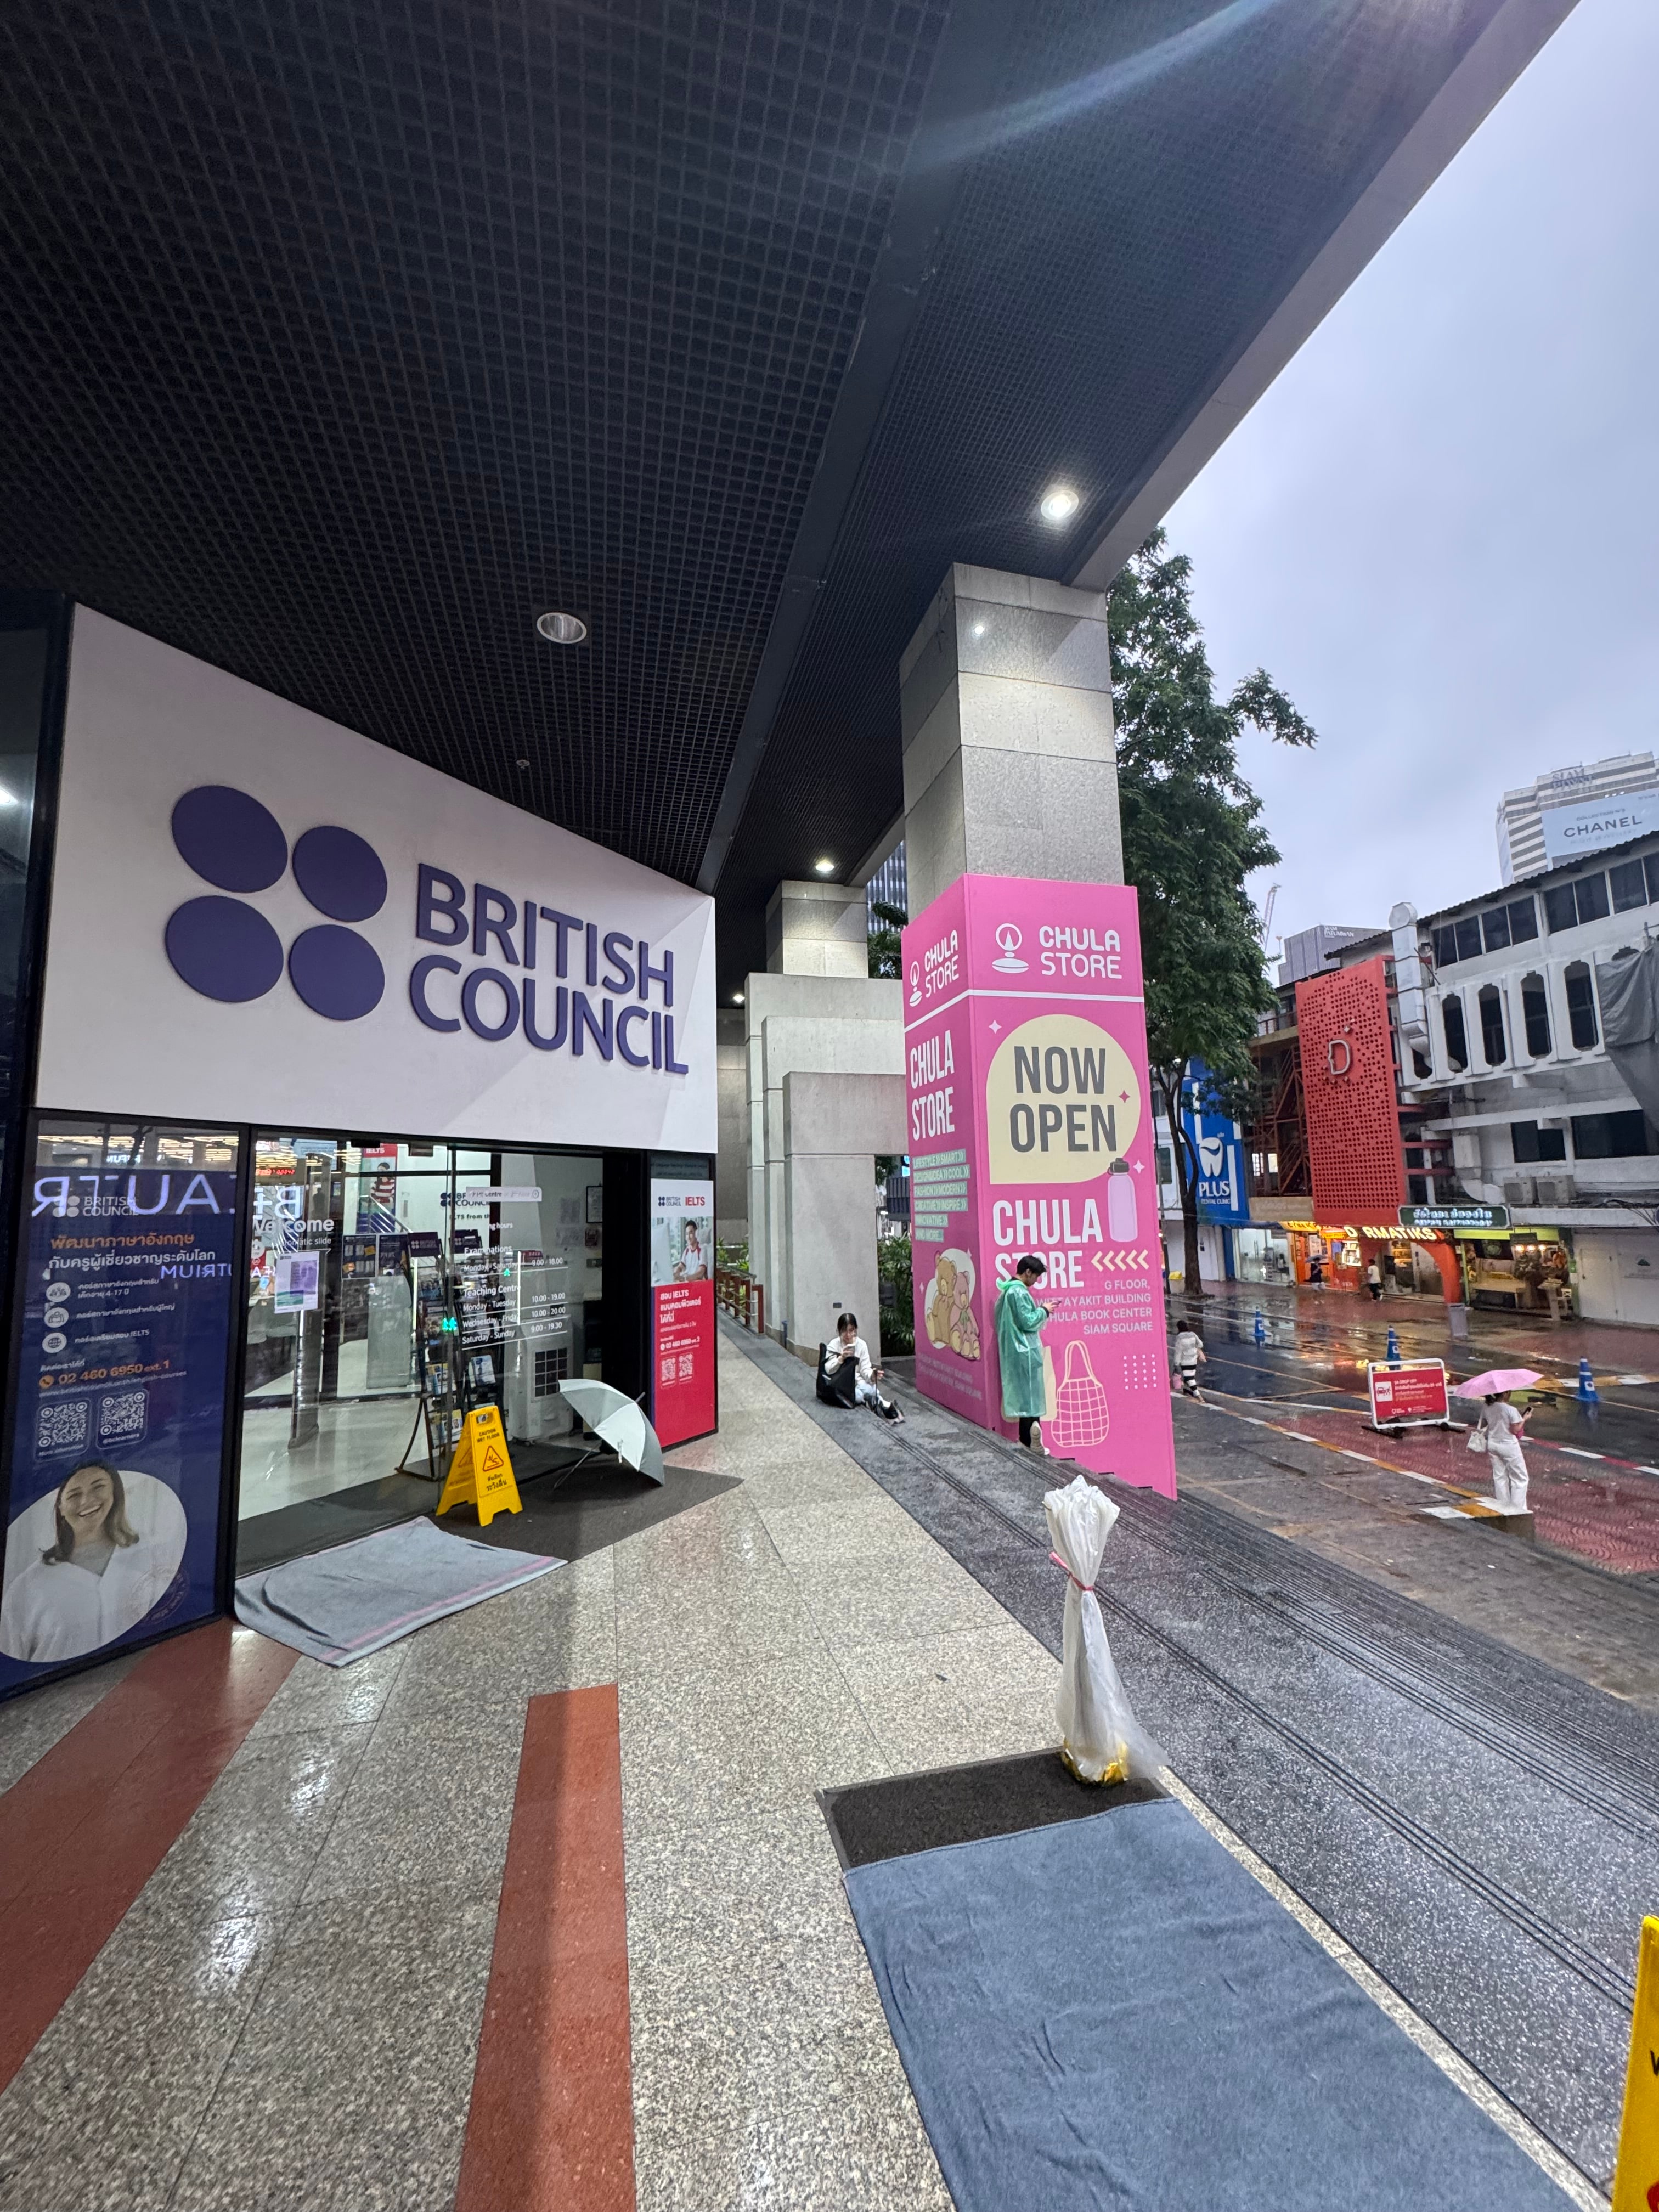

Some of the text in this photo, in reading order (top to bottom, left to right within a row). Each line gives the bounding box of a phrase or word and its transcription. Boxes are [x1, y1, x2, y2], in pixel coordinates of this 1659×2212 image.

[1564, 816, 1643, 838] CHANEL
[416, 863, 674, 1007] BRITISH
[1039, 926, 1120, 952] CHULA
[924, 929, 958, 969] CHULA
[1040, 952, 1122, 979] STORE
[925, 955, 959, 998] STORE
[409, 954, 689, 1075] COUNCIL
[910, 1030, 955, 1089] CHULA
[1014, 1046, 1106, 1094] NOW
[912, 1086, 955, 1141] STORE
[1010, 1103, 1117, 1153] OPEN
[1199, 1181, 1230, 1197] PLUS
[84, 1197, 136, 1206] BRITISH
[685, 1197, 705, 1206] IELTS
[83, 1207, 139, 1216] COUNCIL
[992, 1199, 1103, 1246] CHULA
[50, 1233, 194, 1250] พัฒนาภาษาอังกฤษ
[315, 1237, 331, 1245] slide
[48, 1249, 216, 1272] กับครูผู้เชี่ยวชาญระดับโลก
[464, 1263, 488, 1272] Monday
[493, 1261, 518, 1271] Saturday
[463, 1284, 521, 1297] Teaching Centre
[1105, 1279, 1150, 1290] G FLOOR,
[673, 1289, 689, 1299] IELTS
[1105, 1293, 1151, 1305] BUILDING
[463, 1302, 487, 1312] Monday
[493, 1299, 516, 1309] Tuesday
[1081, 1310, 1110, 1321] BOOK
[1113, 1307, 1152, 1318] CENTER
[462, 1317, 496, 1328] Wednesday
[550, 1307, 566, 1315] 20.00
[462, 1333, 489, 1344] Saturday
[494, 1329, 515, 1339] Sunday
[1084, 1322, 1153, 1335] SIAM SQUARE
[58, 1373, 77, 1385] 02
[80, 1368, 108, 1381] 460
[110, 1364, 144, 1377] 6950
[163, 1359, 170, 1369] 1
[478, 1428, 496, 1437] CAUTION
